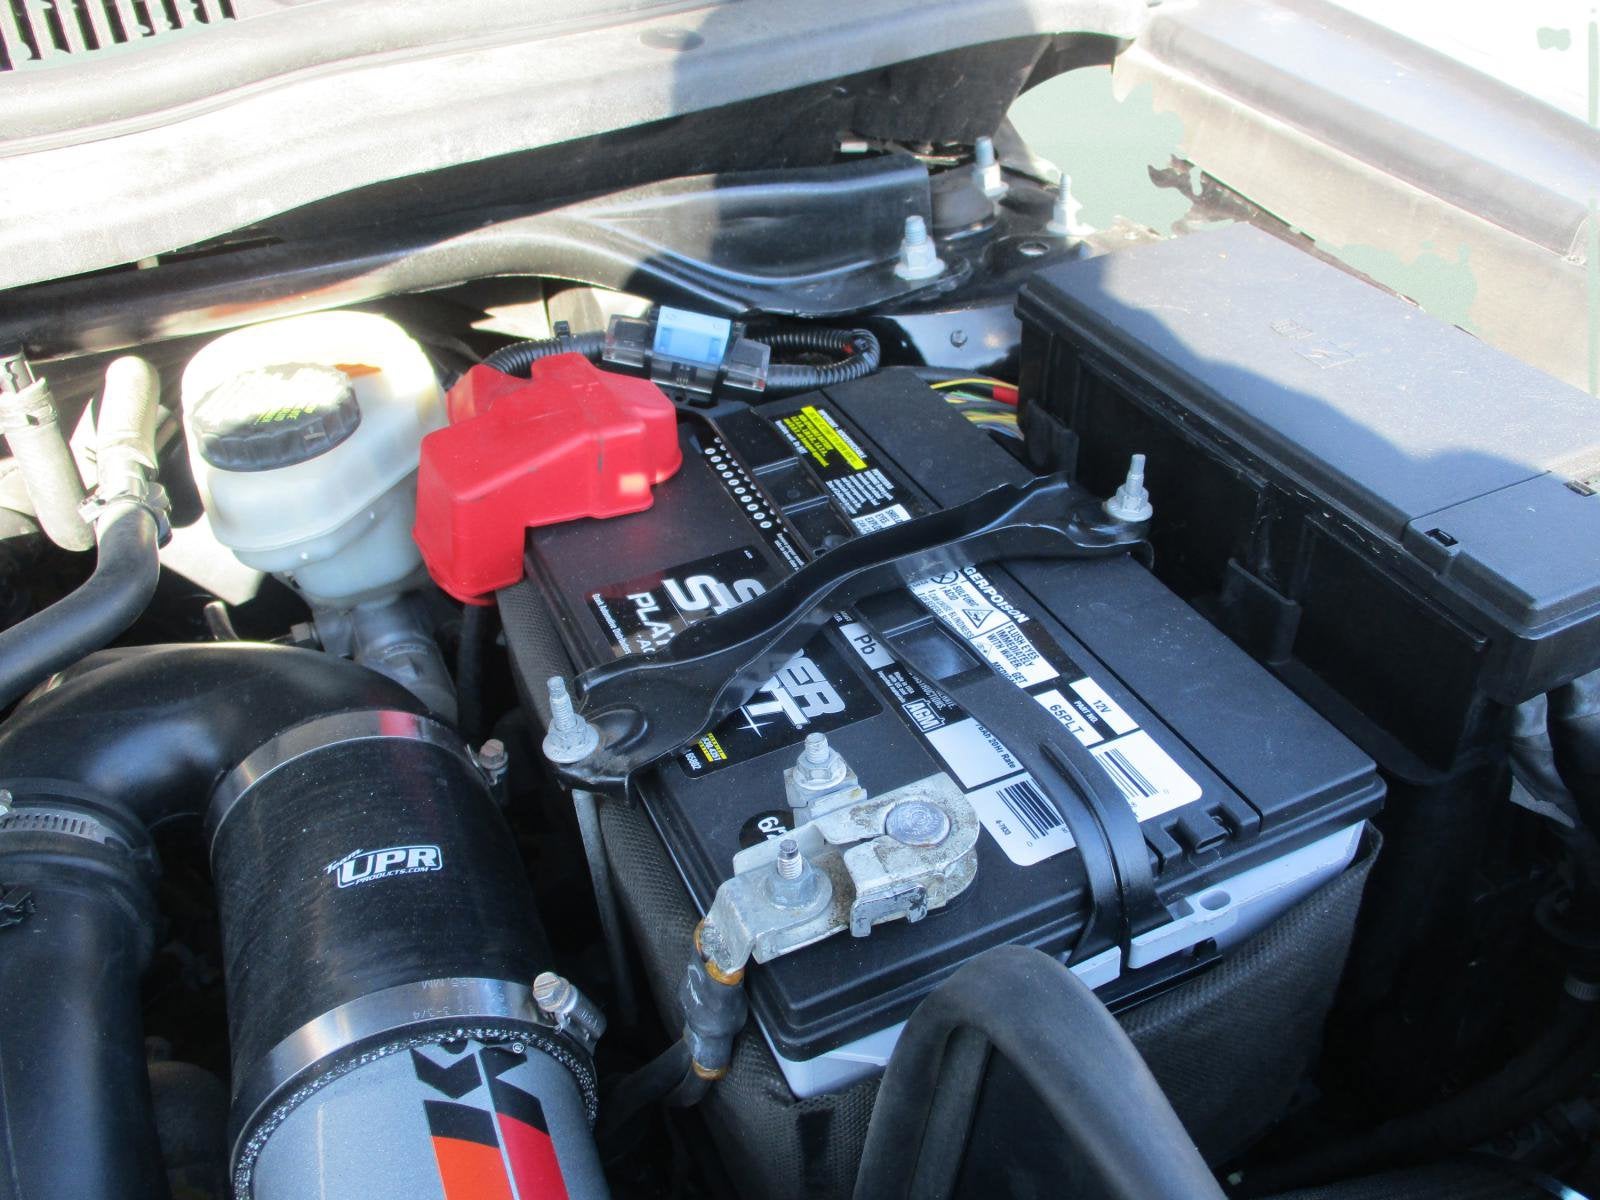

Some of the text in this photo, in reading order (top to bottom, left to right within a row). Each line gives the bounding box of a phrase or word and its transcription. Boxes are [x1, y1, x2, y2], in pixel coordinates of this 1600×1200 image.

[854, 634, 878, 654] Pb
[987, 634, 1004, 653] WITH
[996, 630, 1034, 667] IMMEDIATELY
[1005, 625, 1040, 660] FLUSH EYES
[1012, 671, 1028, 684] GET
[909, 702, 939, 727] AGM
[1074, 701, 1089, 716] PART
[1093, 699, 1111, 713] 12V
[1050, 704, 1084, 733] 65PLT
[1001, 754, 1016, 768] Rate
[342, 848, 437, 883] UPR
[356, 867, 428, 885] PRODUCTS.COM
